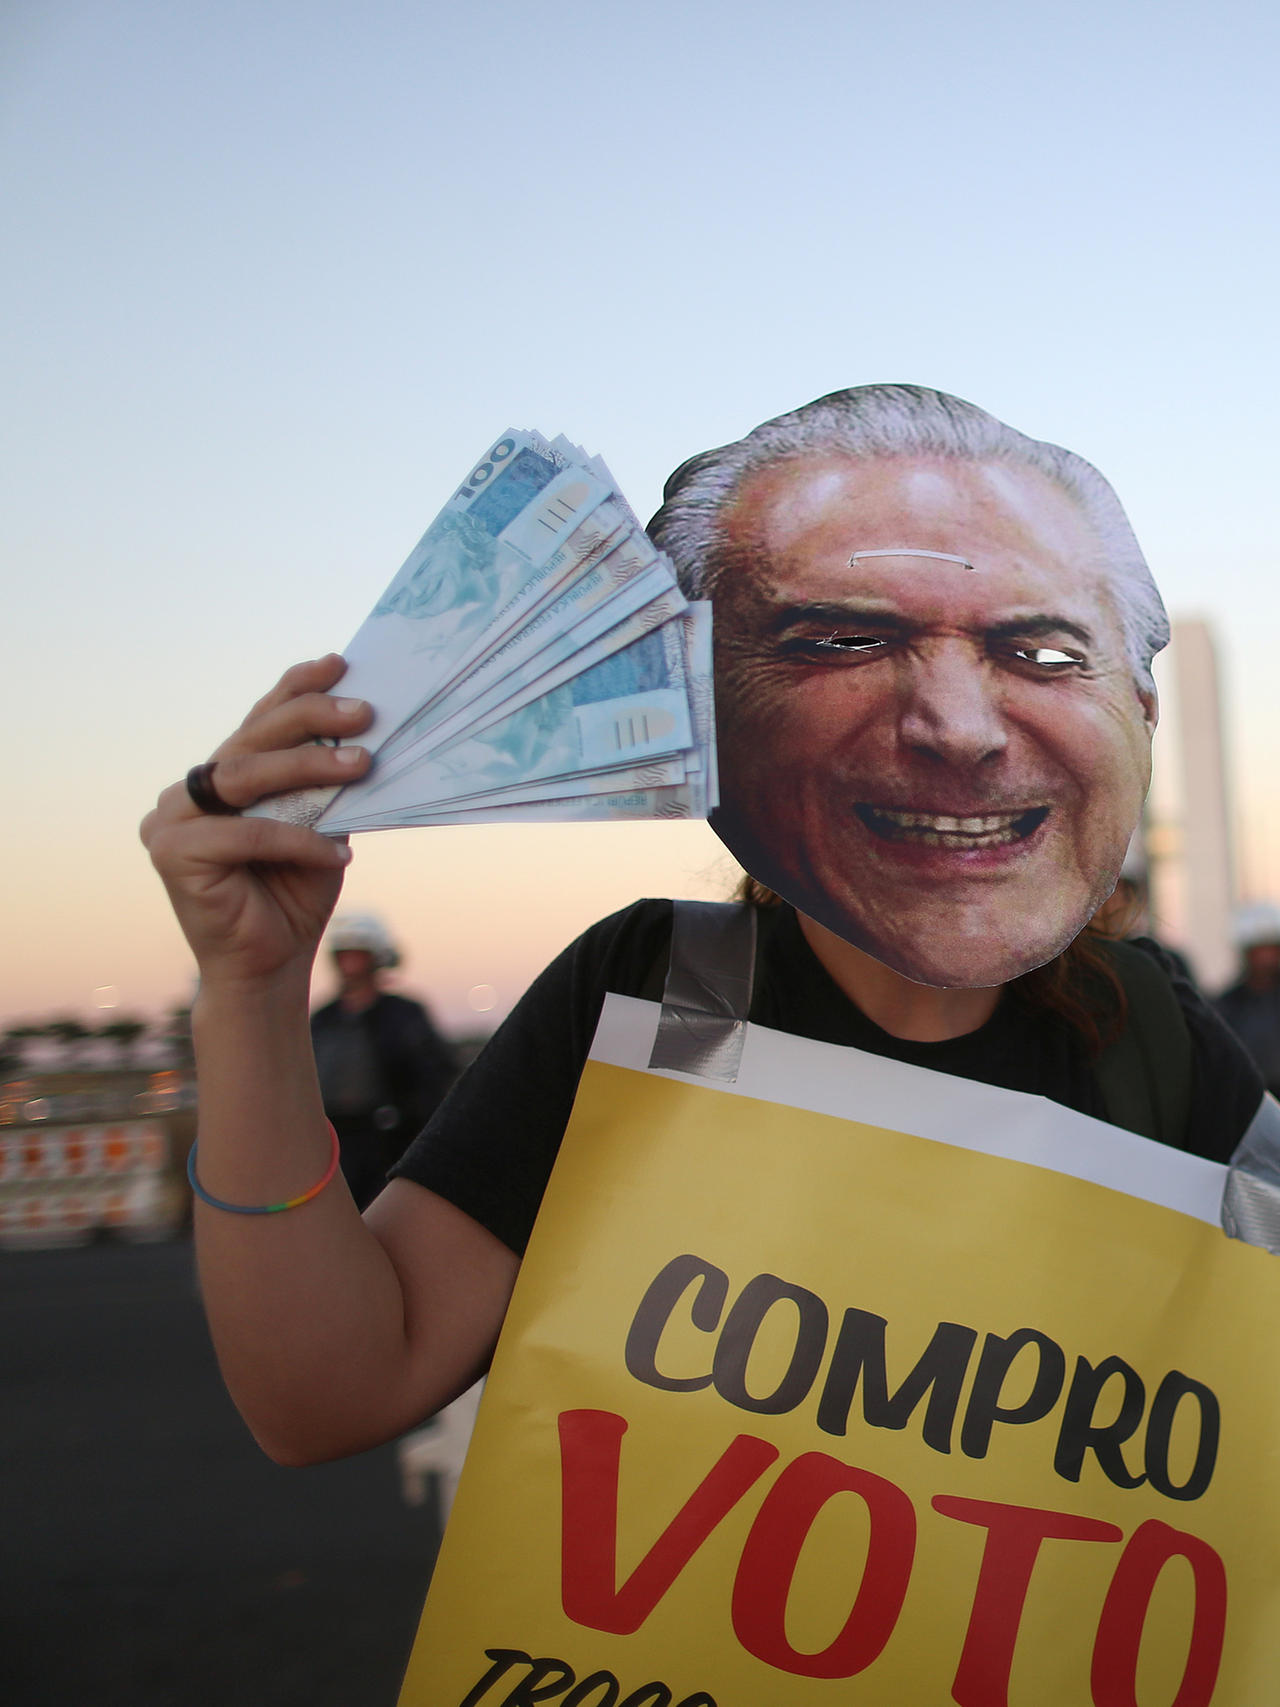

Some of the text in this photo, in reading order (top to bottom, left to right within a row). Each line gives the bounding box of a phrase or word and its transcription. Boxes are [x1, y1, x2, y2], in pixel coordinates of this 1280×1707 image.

[454, 438, 516, 501] 100
[625, 1254, 1221, 1502] COMPRO
[557, 1408, 1229, 1707] VOTO
